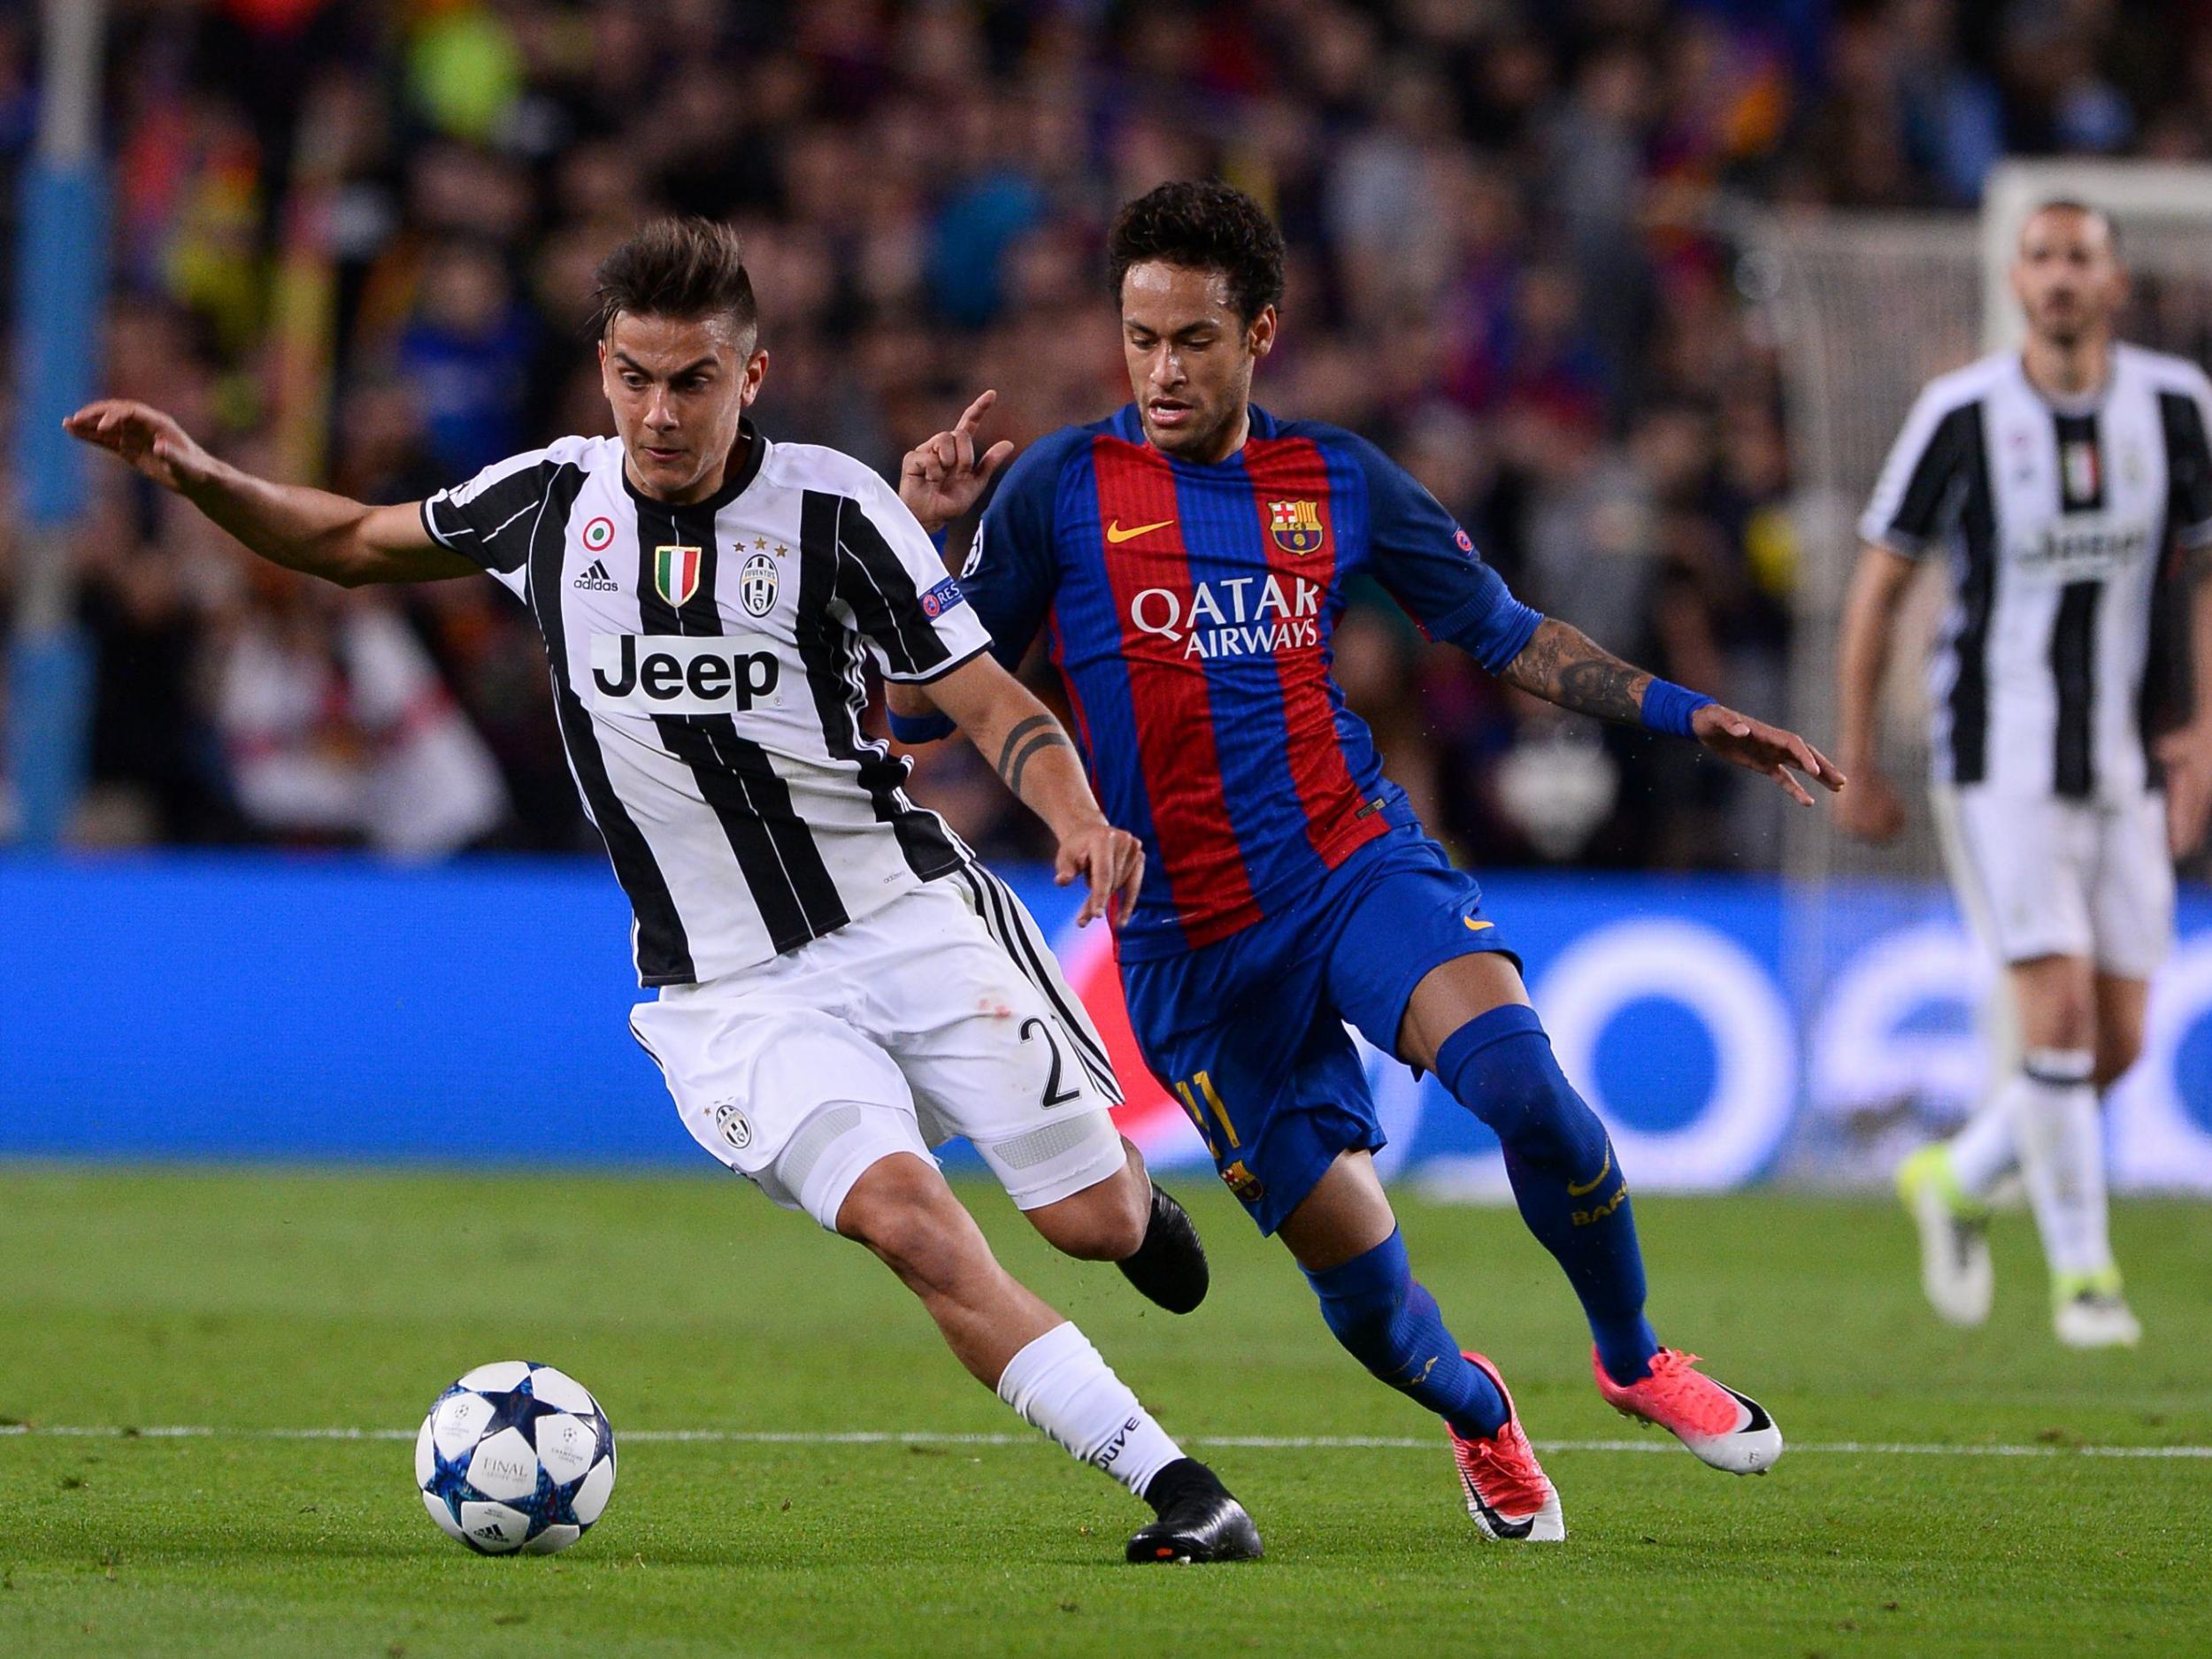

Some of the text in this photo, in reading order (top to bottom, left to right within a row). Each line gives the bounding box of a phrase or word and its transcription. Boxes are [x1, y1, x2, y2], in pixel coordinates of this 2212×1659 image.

[573, 578, 618, 592] adidas
[1131, 574, 1320, 642] QATAR
[1184, 618, 1317, 660] AIRWAYS
[592, 634, 780, 711] Jeep
[1018, 1013, 1098, 1110] 2
[1175, 1070, 1241, 1160] 11
[483, 1456, 527, 1478] FINAL
[1097, 1417, 1141, 1471] JUVE
